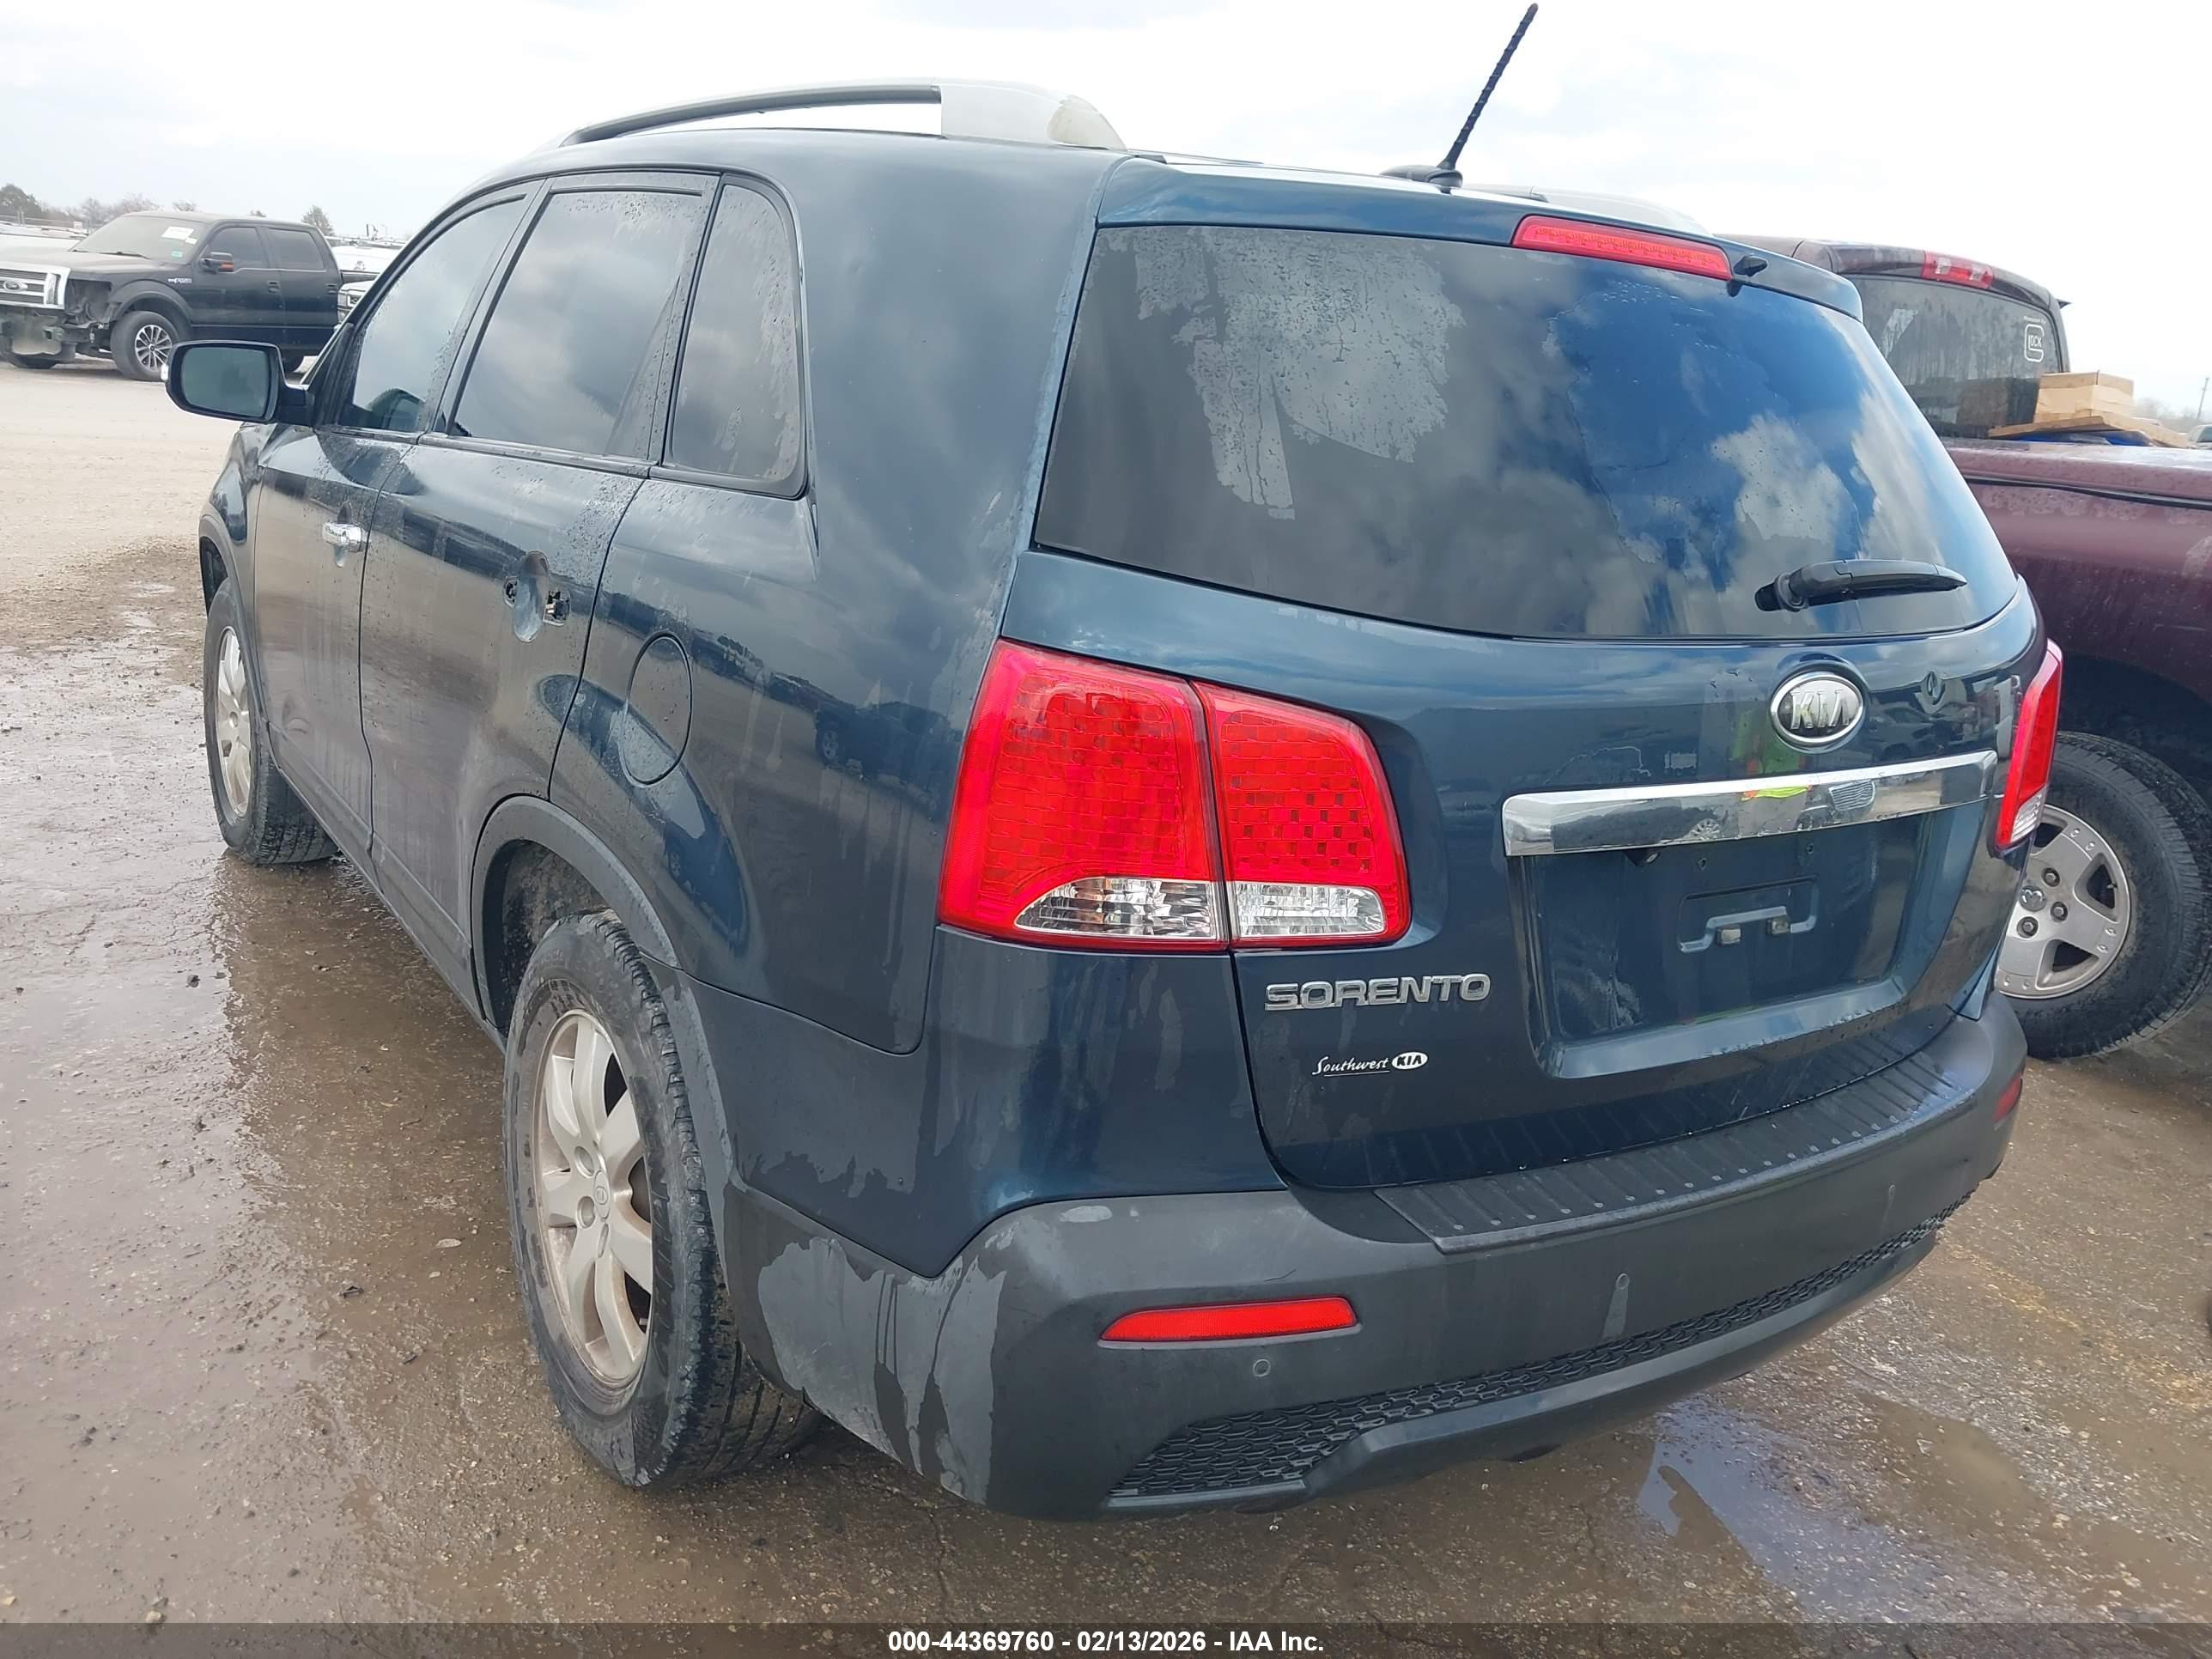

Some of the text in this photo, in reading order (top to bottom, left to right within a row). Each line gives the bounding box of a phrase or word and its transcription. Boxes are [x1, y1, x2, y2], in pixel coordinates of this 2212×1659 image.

[1790, 689, 1850, 730] KIA
[1265, 973, 1491, 1011] SORENTO
[1311, 1054, 1424, 1075] Southwest KIA
